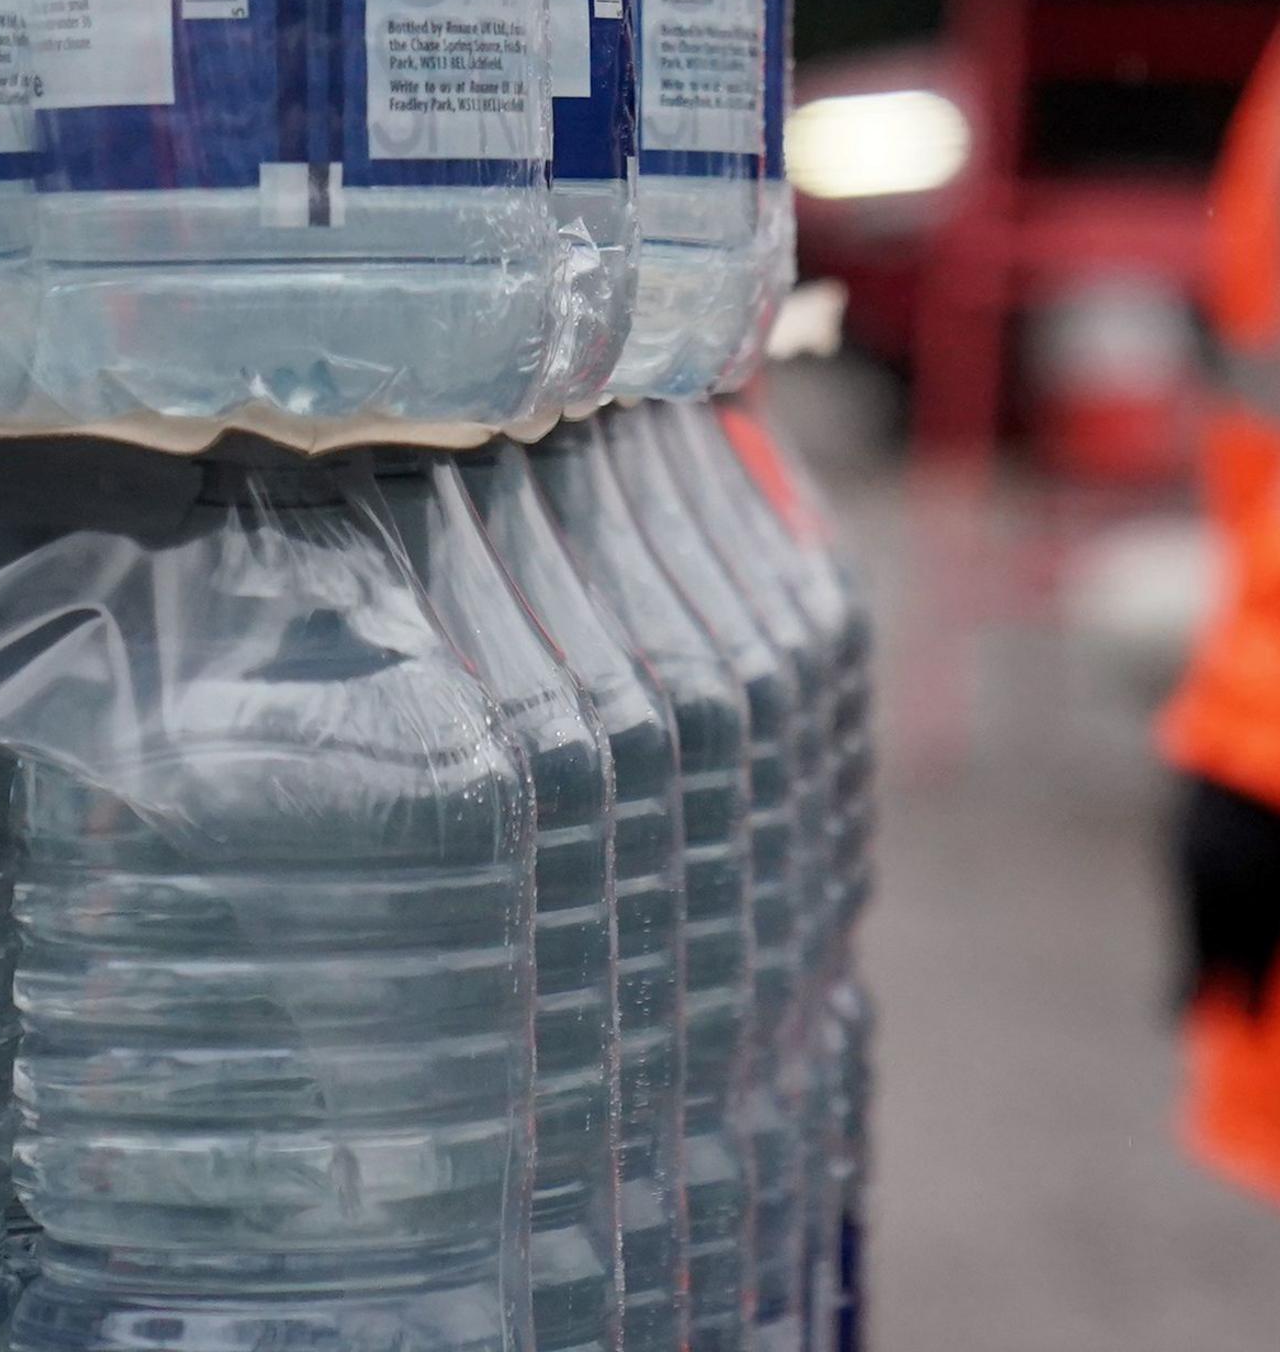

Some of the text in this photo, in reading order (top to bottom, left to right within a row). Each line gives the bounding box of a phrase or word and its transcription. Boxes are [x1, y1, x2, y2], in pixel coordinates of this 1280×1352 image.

[388, 21, 429, 35] Bottled
[432, 21, 442, 37] by
[389, 40, 407, 51] the
[410, 39, 440, 52] Chase
[390, 56, 418, 71] Park,
[421, 57, 448, 71] WS13
[390, 80, 419, 94] Write
[425, 82, 435, 94] to
[455, 81, 465, 94] at
[389, 98, 428, 113] Fradley
[430, 98, 455, 113] Park,
